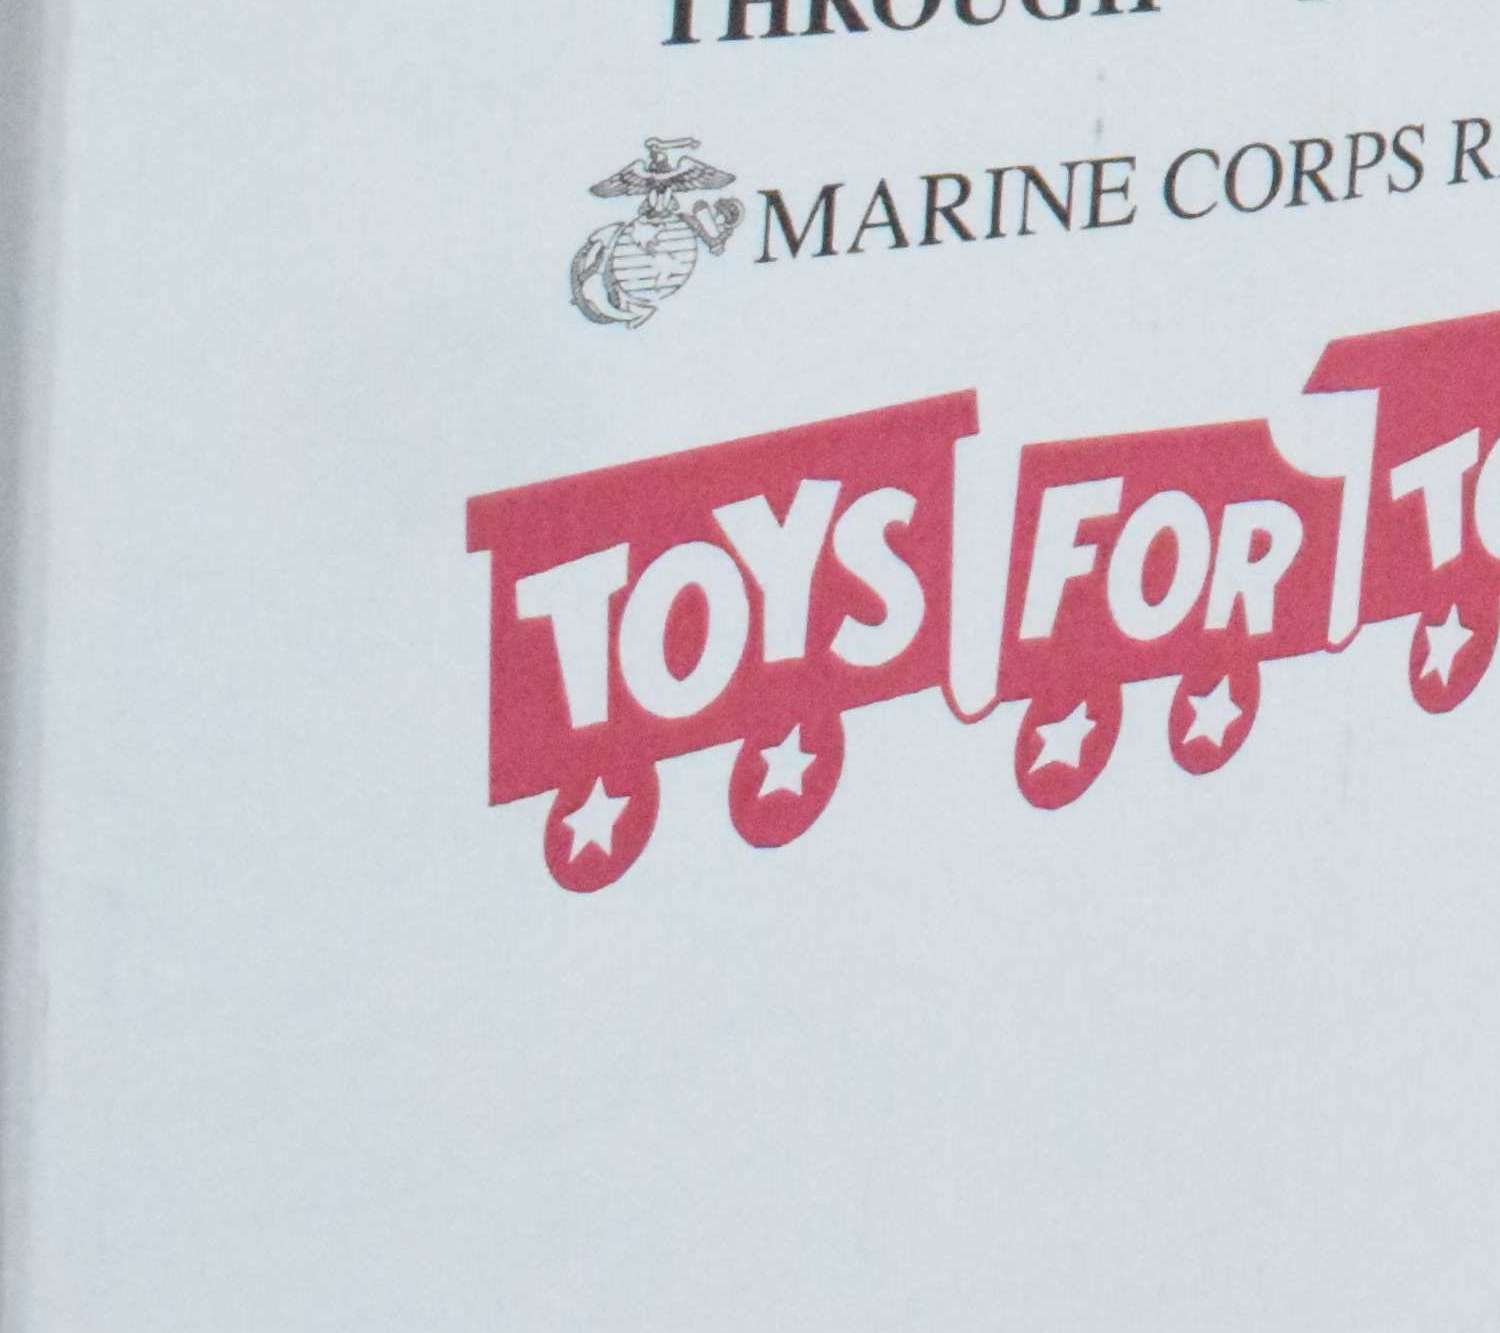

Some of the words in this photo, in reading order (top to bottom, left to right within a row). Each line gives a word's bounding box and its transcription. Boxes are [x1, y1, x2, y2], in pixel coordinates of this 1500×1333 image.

[755, 154, 1138, 265] MARINE
[1161, 122, 1426, 220] CORPS
[516, 476, 926, 732] TOYS
[1018, 476, 1305, 643] FOR
